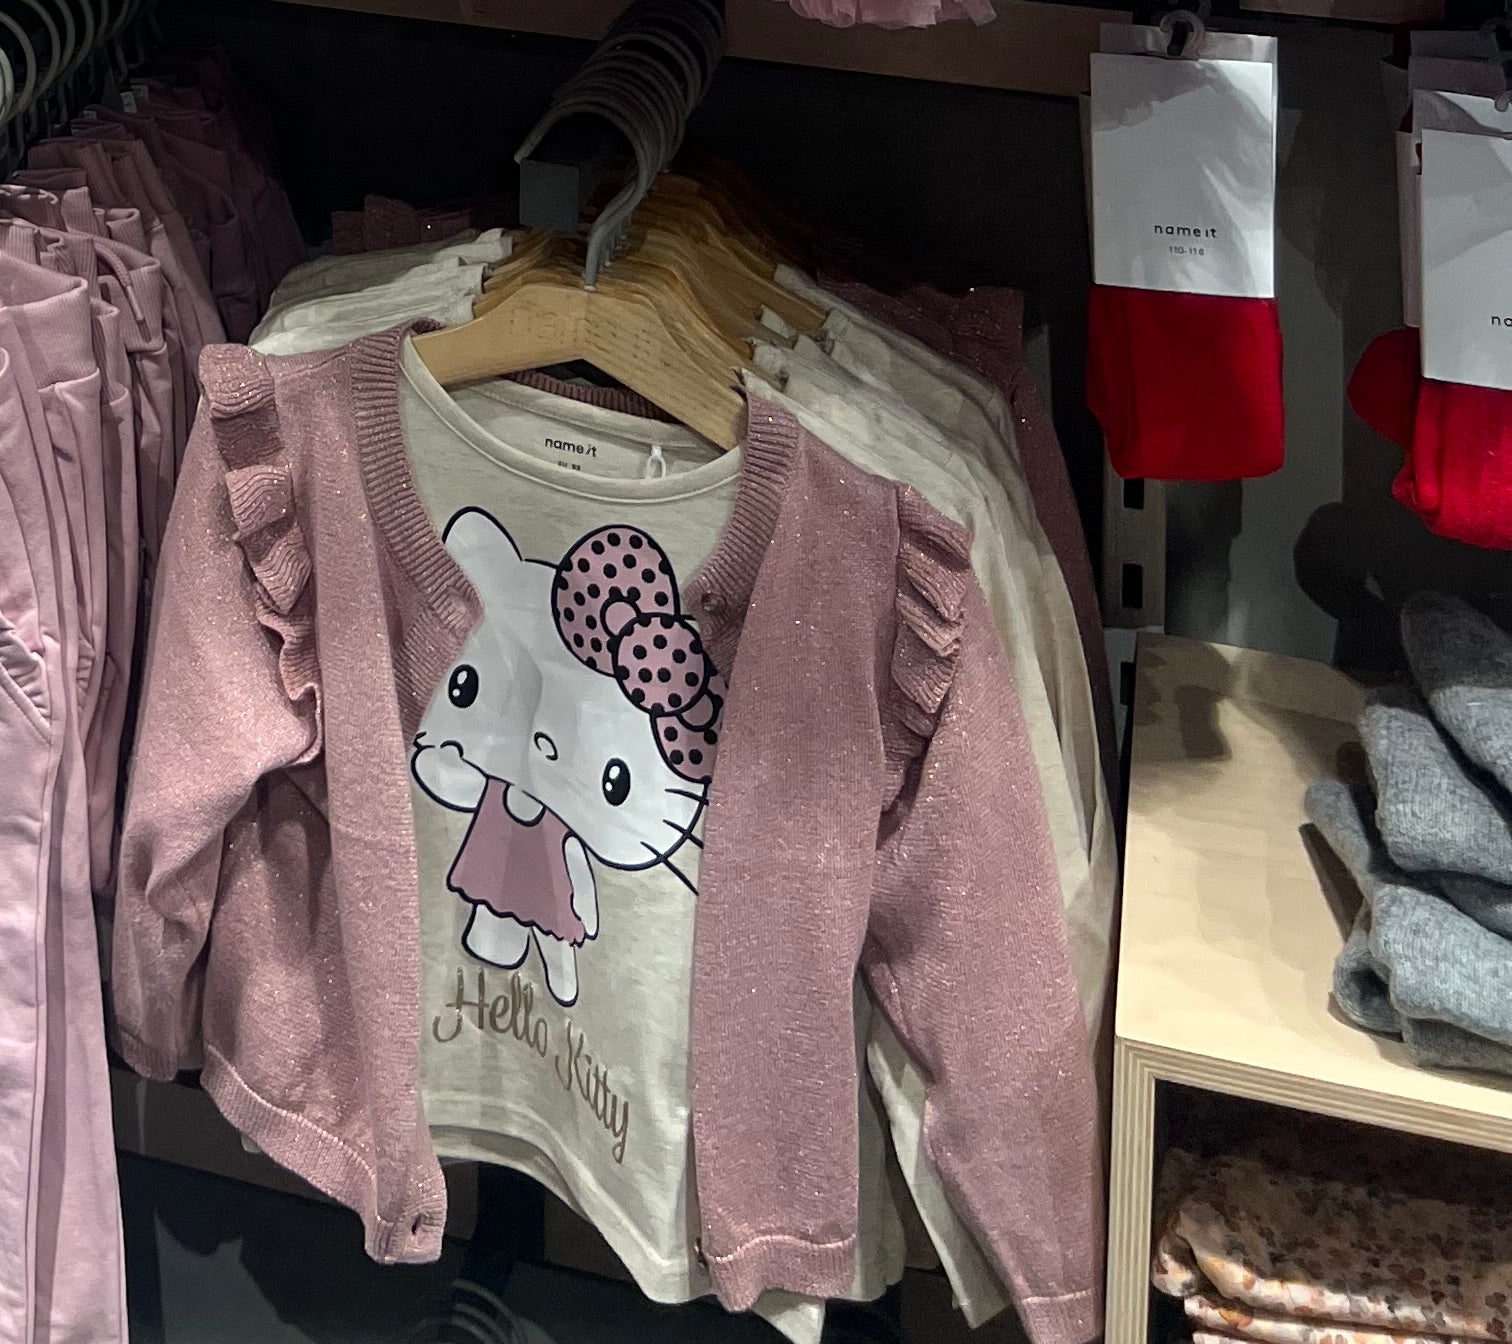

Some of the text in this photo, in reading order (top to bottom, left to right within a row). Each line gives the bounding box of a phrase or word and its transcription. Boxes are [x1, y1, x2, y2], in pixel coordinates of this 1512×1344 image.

[1154, 224, 1217, 239] name it
[544, 438, 597, 457] name it
[432, 967, 629, 1164] Hello Kitty
